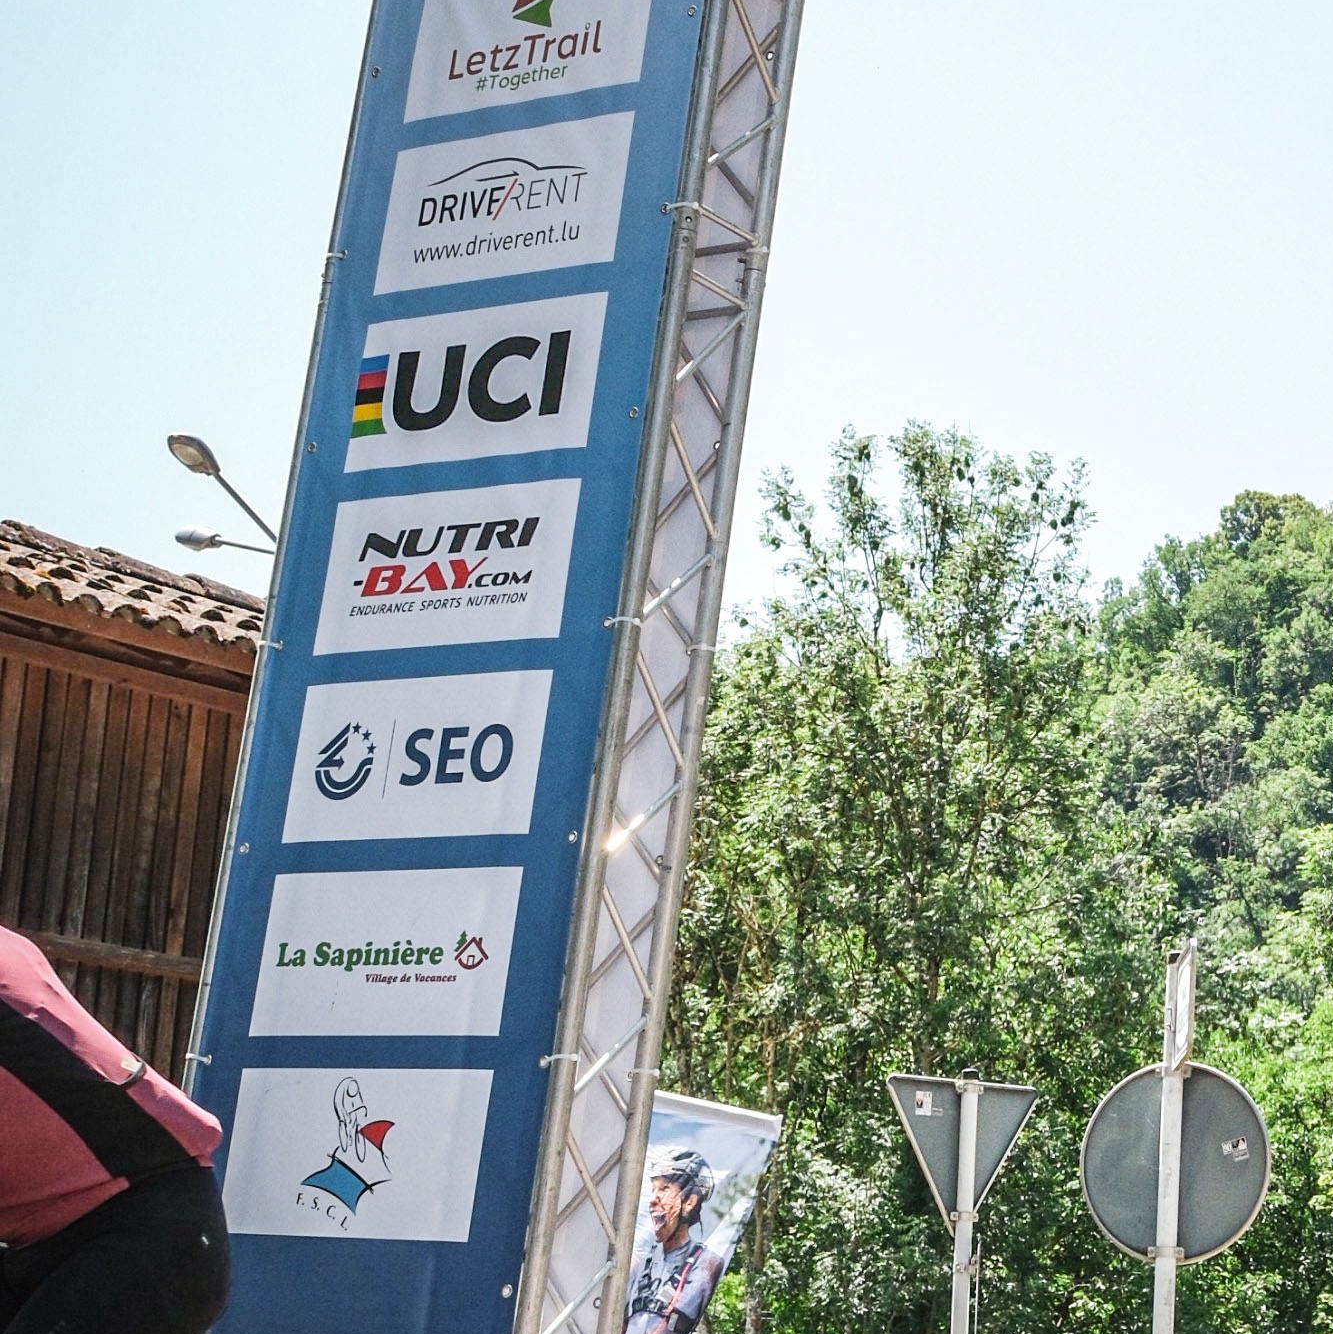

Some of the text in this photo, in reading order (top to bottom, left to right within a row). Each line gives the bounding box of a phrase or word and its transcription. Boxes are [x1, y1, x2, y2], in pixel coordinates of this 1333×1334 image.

[447, 19, 603, 82] LetzTrail
[475, 62, 569, 92] #Together
[412, 220, 581, 264] www.driverent.lu
[392, 329, 572, 431] UCI
[358, 516, 541, 562] NUTRI
[349, 592, 529, 617] ENDURANCE SPORTS NUTRITION
[399, 722, 514, 787] SEO
[276, 940, 445, 972] La Sapinière
[365, 972, 457, 985] Village de Vacances
